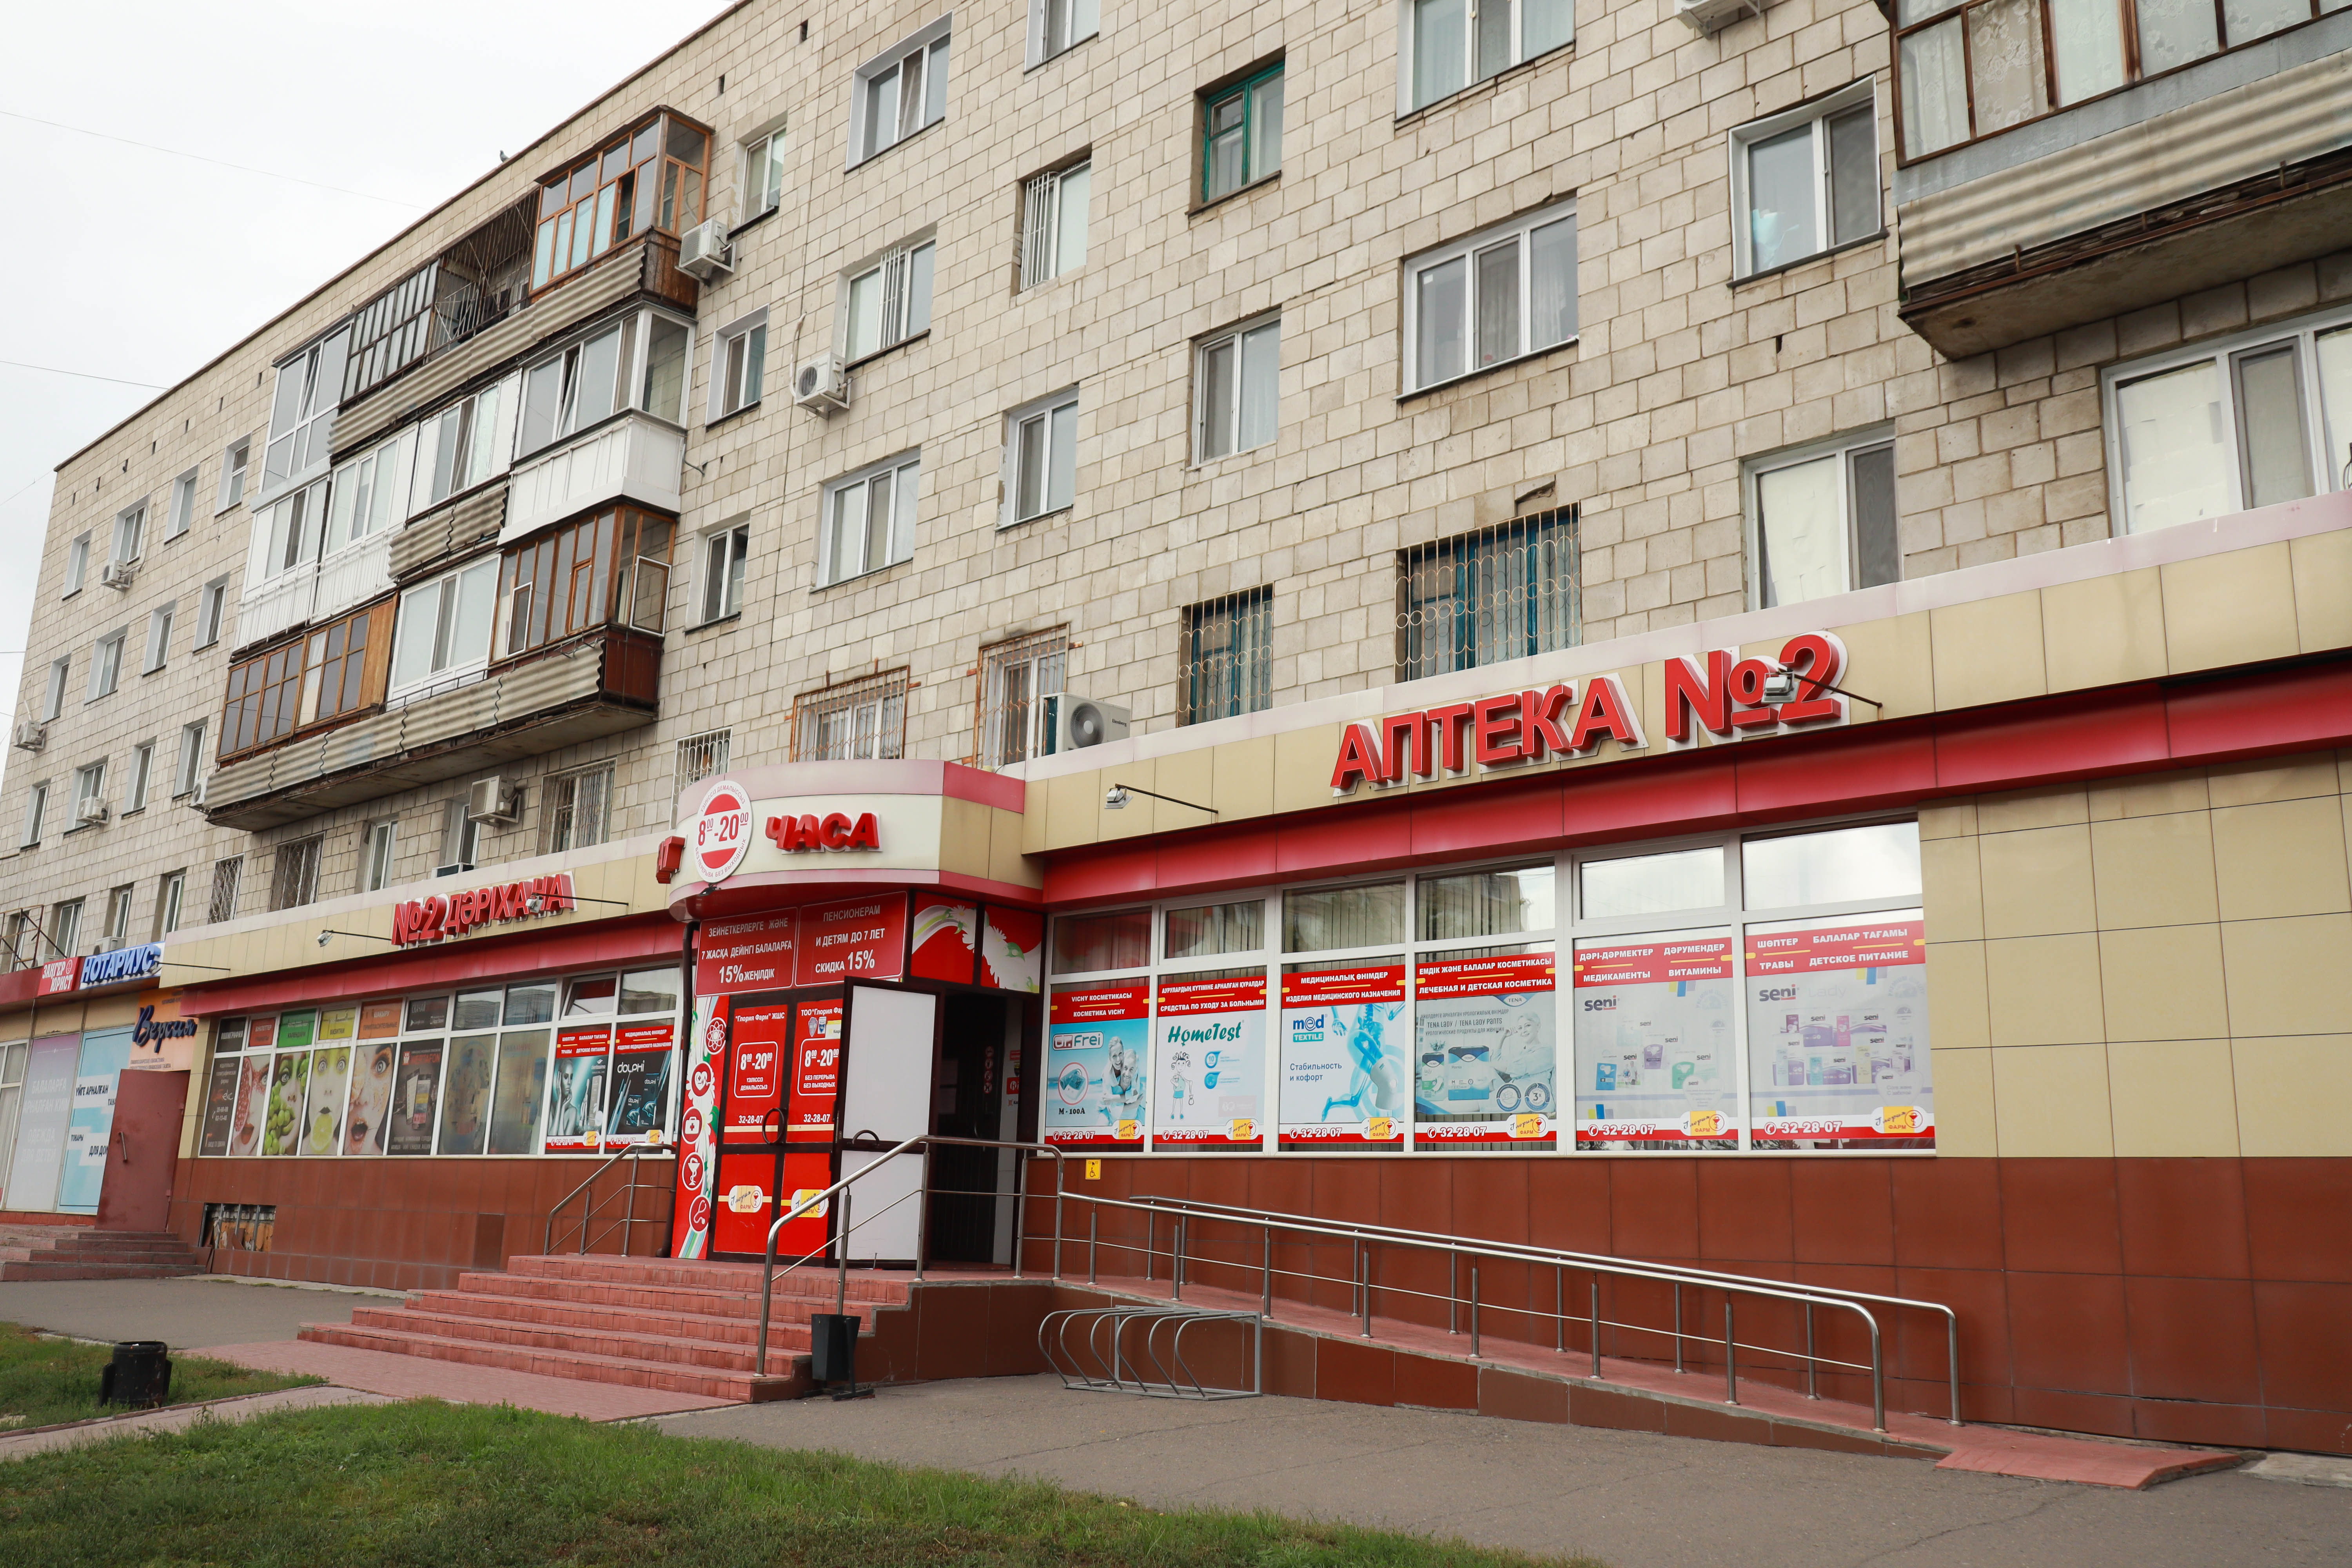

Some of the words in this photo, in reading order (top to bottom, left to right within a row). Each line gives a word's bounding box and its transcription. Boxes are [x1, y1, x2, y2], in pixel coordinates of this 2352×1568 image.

[1330, 677, 1638, 789] АПТЕКА
[1664, 635, 1841, 740] №2
[717, 785, 746, 804] ДЕМАЛЫССЫЗ
[765, 812, 881, 851] ЧАСА
[697, 860, 714, 877] ПЕРЕРЫВА
[724, 838, 746, 873] ВЫХОДНЫХ
[392, 896, 444, 946] №2
[444, 874, 574, 935] ДӘРІХАНА
[823, 905, 880, 922] ПЕНСИОНЕРАМ
[708, 921, 764, 937] ЗЕЙНЕТКЕРЛЕРГЕ
[768, 918, 788, 929] ЖӘНЕ
[815, 937, 821, 946] И
[822, 933, 848, 947] ДЕТЯМ
[850, 931, 862, 944] ДО
[864, 930, 869, 940] 7
[869, 928, 885, 939] ЛЕТ
[1757, 938, 1798, 948] ШӨПТЕР
[1813, 933, 1860, 944] БАЛАЛАР
[1863, 929, 1907, 939] ТАҒАМЫ
[702, 951, 706, 960] 7
[706, 948, 729, 960] ЖАСҚА
[730, 944, 754, 958] ДЕЙІНГІ
[755, 940, 792, 953] БАЛАЛАРҒА
[1580, 949, 1654, 962] ДӘРІ-ДӘРМЕКТЕР
[1664, 944, 1725, 955] ДӘРУМЕНДЕР
[82, 945, 160, 982] НОТАРИУС
[815, 960, 845, 974] СКИДКА
[847, 949, 875, 970] 15%
[1463, 962, 1495, 971] БАЛАЛАР
[1497, 958, 1552, 968] КОСМЕТИКАСЫ
[1760, 960, 1794, 970] ТРАВЫ
[1809, 955, 1856, 967] ДЕТСКОЕ
[1858, 951, 1909, 962] ПИТАНИЕ
[42, 961, 66, 980] ЗАҢГЕР
[719, 964, 744, 984] 15%
[744, 968, 775, 981] ЖЕҢІЛДІК
[1301, 974, 1355, 984] МЕДИЦИНАЛЫҚ
[1356, 972, 1388, 980] ӨНІМДЕР
[1583, 971, 1651, 982] МЕДИКАМЕНТЫ
[1669, 967, 1722, 976] ВИТАМИНЫ
[50, 975, 73, 992] ЮРИСТ
[1419, 985, 1458, 994] ЛЕЧЕБНАЯ
[1468, 983, 1503, 991] ДЕТСКАЯ
[1504, 978, 1552, 988] КОСМЕТИКА
[1089, 993, 1132, 1001] КОСМЕТИКАСЫ
[1361, 989, 1400, 998] НАЗНАЧЕНИЯ
[1759, 984, 1796, 1002] seni
[1584, 995, 1617, 1011] seni
[132, 1005, 198, 1053] Версия
[1168, 1022, 1241, 1047] HomeTest
[1074, 1034, 1100, 1047] Frei
[1290, 1062, 1342, 1071] Стабильность
[1296, 1074, 1323, 1082] кофорт
[86, 1085, 109, 1095] АРНАЛҒАН
[739, 1115, 764, 1124] 32-28-07
[804, 1114, 830, 1122] 32-28-07
[1172, 1130, 1183, 1140] 32
[1185, 1130, 1196, 1140] 28
[1198, 1130, 1209, 1139] 07
[1301, 1128, 1312, 1138] 32
[1315, 1128, 1327, 1138] 28
[1330, 1127, 1343, 1137] 07
[1781, 1122, 1798, 1134] 32
[1803, 1122, 1820, 1133] 28
[1824, 1121, 1842, 1133] 07
[89, 1145, 99, 1157] ДЛЯ
